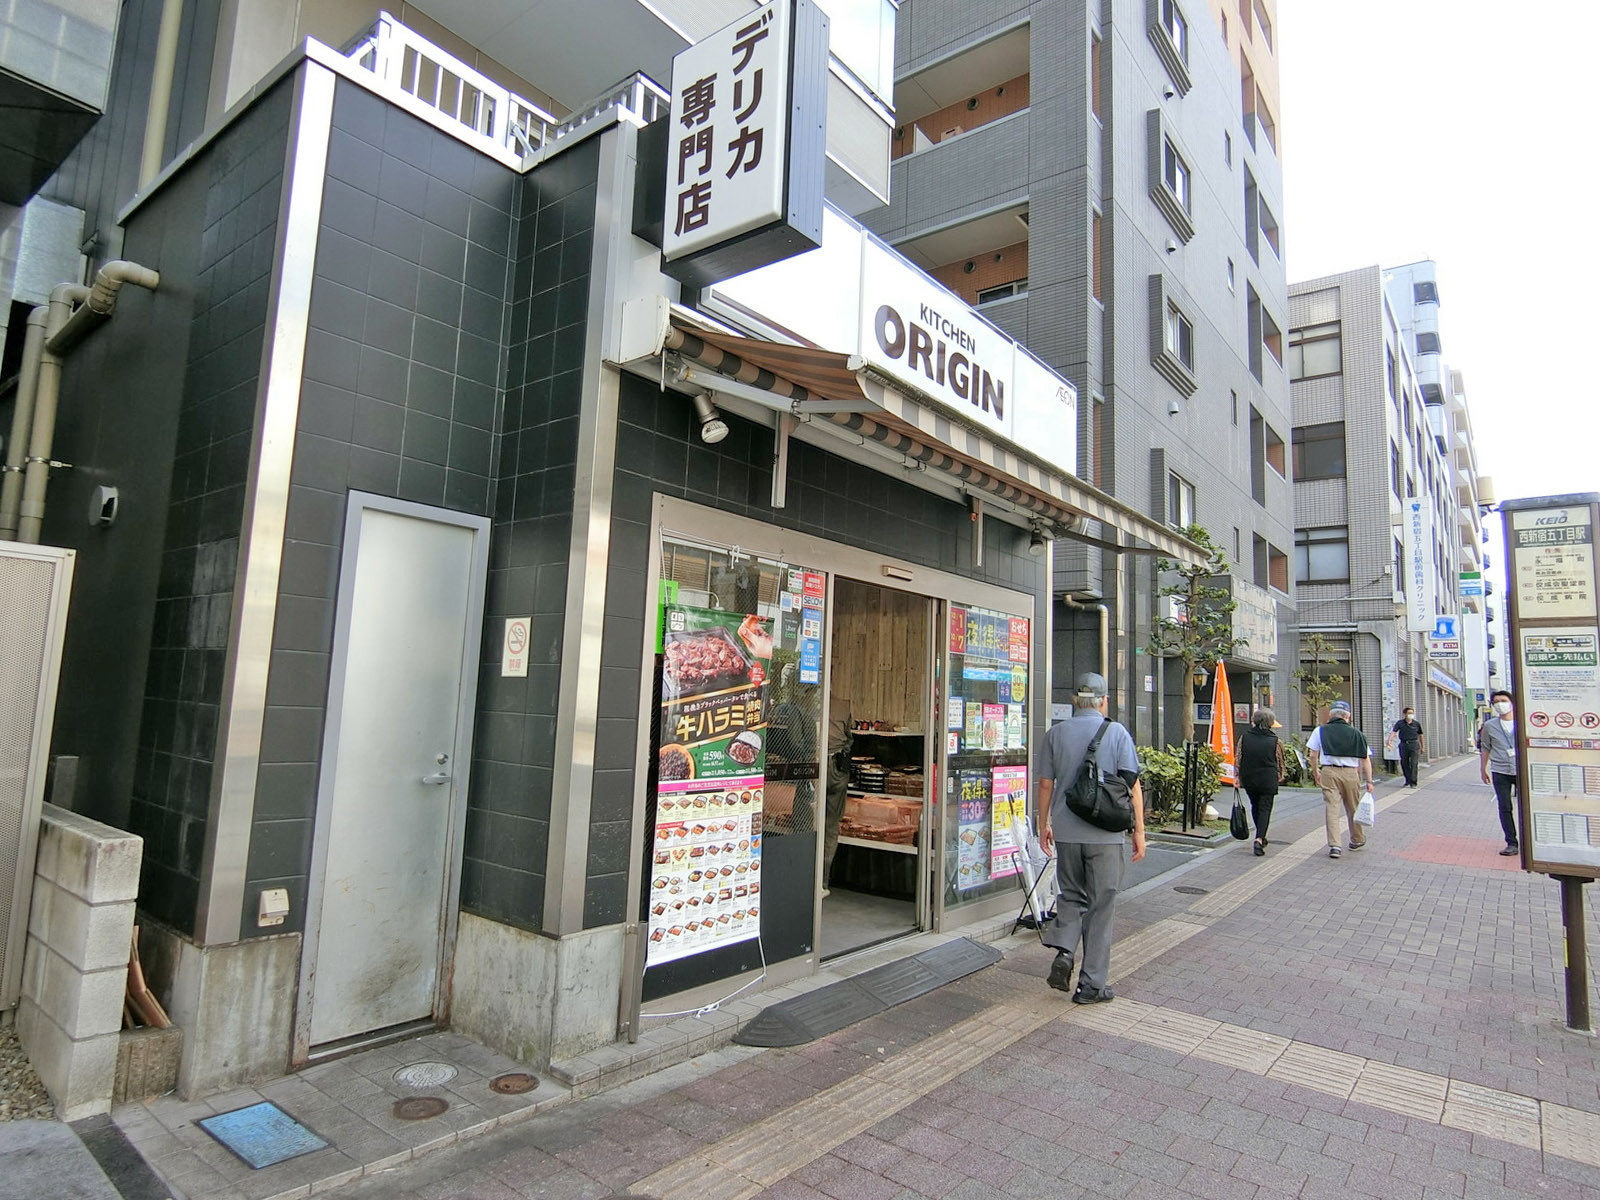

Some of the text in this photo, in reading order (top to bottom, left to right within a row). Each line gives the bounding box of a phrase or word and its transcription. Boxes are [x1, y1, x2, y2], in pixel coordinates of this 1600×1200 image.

[726, 9, 774, 179] デリカ
[674, 73, 718, 237] 専門店
[920, 301, 976, 355] KITCHEN
[874, 304, 1005, 421] ORIGIN
[1518, 528, 1586, 544] 西新宿五丁目駅
[1535, 515, 1568, 525] KEIO
[803, 596, 823, 606] SECOM
[676, 705, 745, 741] 牛ハラミ
